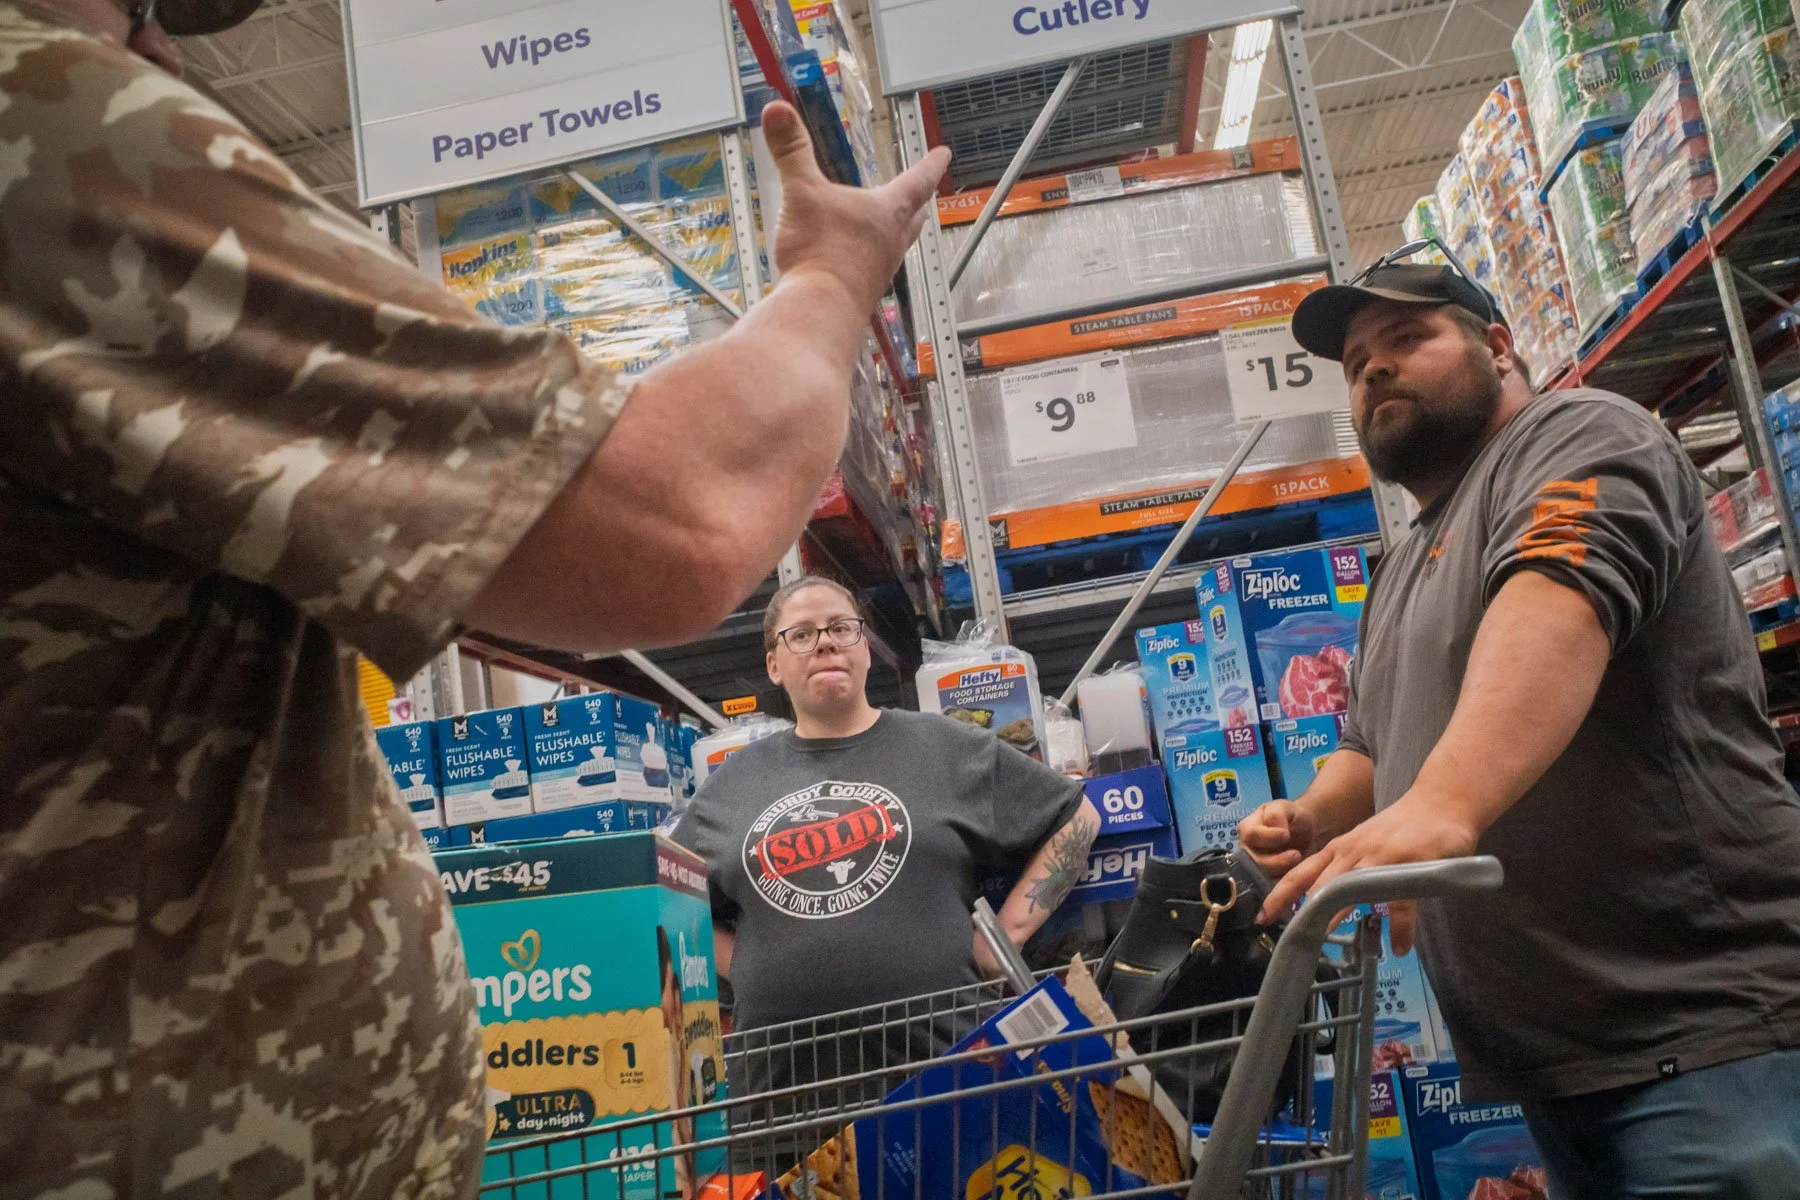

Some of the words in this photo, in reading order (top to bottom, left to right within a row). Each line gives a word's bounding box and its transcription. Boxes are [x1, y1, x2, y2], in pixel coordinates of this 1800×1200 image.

[1012, 0, 1152, 37] Cutlery
[480, 26, 592, 69] Wipes
[432, 120, 533, 163] Paper
[539, 89, 662, 139] Towels
[616, 180, 647, 196] 1200
[938, 196, 970, 211] PAC
[449, 239, 518, 279] Napkins
[1073, 320, 1109, 334] STEAM
[1111, 314, 1142, 327] TABLE
[1145, 308, 1174, 322] PANS
[1103, 500, 1139, 513] STEAM
[1143, 494, 1173, 507] TABLE
[1177, 487, 1206, 501] PANS
[1333, 555, 1359, 571] 152
[1216, 564, 1229, 581] 152
[1335, 569, 1361, 578] GALLON
[1245, 571, 1302, 600] Ziploc
[1342, 586, 1361, 594] SAVE
[1268, 593, 1329, 610] FREEZER
[1147, 637, 1180, 655] Ziploc
[1177, 659, 1188, 671] 9
[961, 670, 1001, 686] Hefty
[949, 689, 973, 700] FOOD
[975, 681, 1016, 695] STORAGE
[956, 690, 1010, 706] CONTAINERS
[584, 698, 602, 709] 540
[495, 713, 513, 725] 540
[591, 712, 598, 721] 9
[405, 726, 422, 738] 540
[502, 727, 509, 736] 9
[1227, 727, 1253, 744] 152
[411, 740, 418, 749] 9
[445, 745, 463, 754] FRESH
[463, 743, 481, 752] SCENT
[1230, 741, 1254, 750] FREEZER
[1286, 732, 1329, 754] Ziploc
[536, 750, 575, 767] WIPES
[1175, 748, 1218, 770] Ziploc
[447, 764, 485, 780] WIPES
[1214, 777, 1228, 792] 9
[1102, 785, 1144, 814] 60
[596, 807, 614, 820] 540
[753, 785, 823, 833] GRUNDY
[829, 784, 900, 810] COUNTY
[1108, 811, 1144, 825] PIECES
[603, 823, 610, 832] 9
[770, 812, 878, 870] SOLD
[439, 866, 491, 894] AVE
[757, 871, 791, 907] GOING
[789, 892, 825, 916] ONCE,
[828, 883, 869, 914] GOING
[864, 850, 900, 893] TWICE
[678, 930, 710, 996] Pampers
[471, 963, 593, 1018] mpers
[486, 1038, 601, 1069] ddlers
[621, 1041, 637, 1070] 1
[1369, 1082, 1391, 1100] 52
[1420, 1083, 1461, 1114] Zipl
[516, 1092, 583, 1116] ULTRA
[1369, 1099, 1393, 1108] ALLON
[1449, 1104, 1524, 1126] FREEZER
